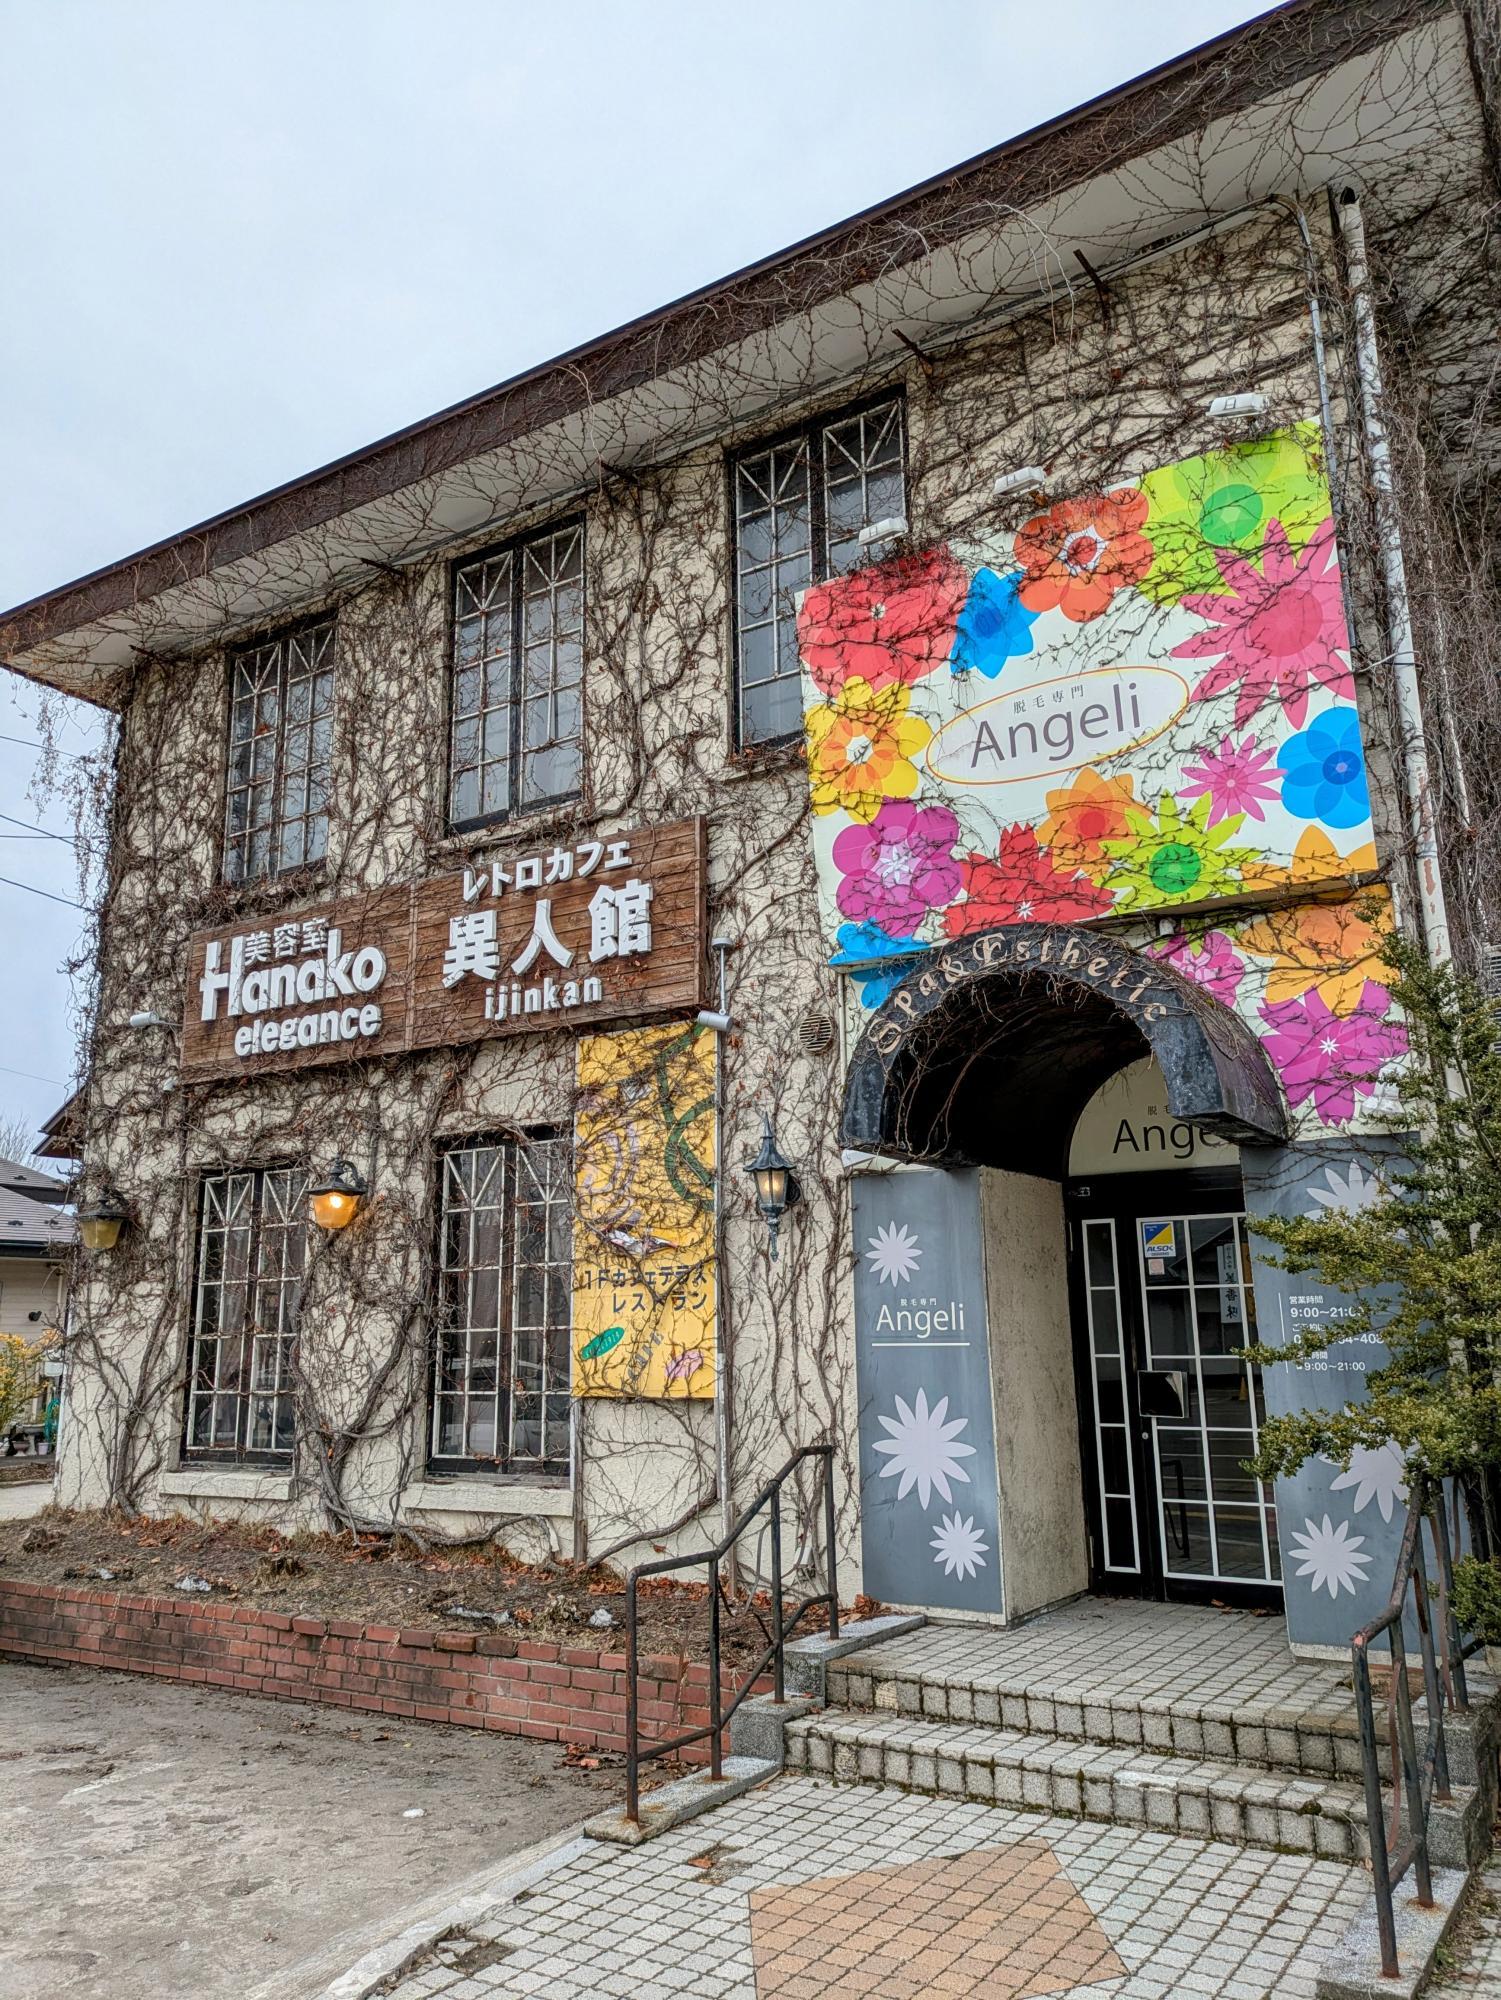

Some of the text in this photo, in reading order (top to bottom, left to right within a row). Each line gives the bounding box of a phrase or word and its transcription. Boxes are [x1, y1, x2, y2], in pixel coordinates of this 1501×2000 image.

[970, 682, 1141, 768] Angeli
[1013, 684, 1084, 714] 脱毛専門
[463, 840, 633, 902] レトロカフェ
[244, 917, 330, 966] 美容室
[442, 878, 654, 989] 異人館
[199, 928, 387, 1022] Hanako
[484, 976, 603, 1021] ijinkan
[234, 1004, 383, 1056] elegance
[876, 1302, 965, 1339] Angeli
